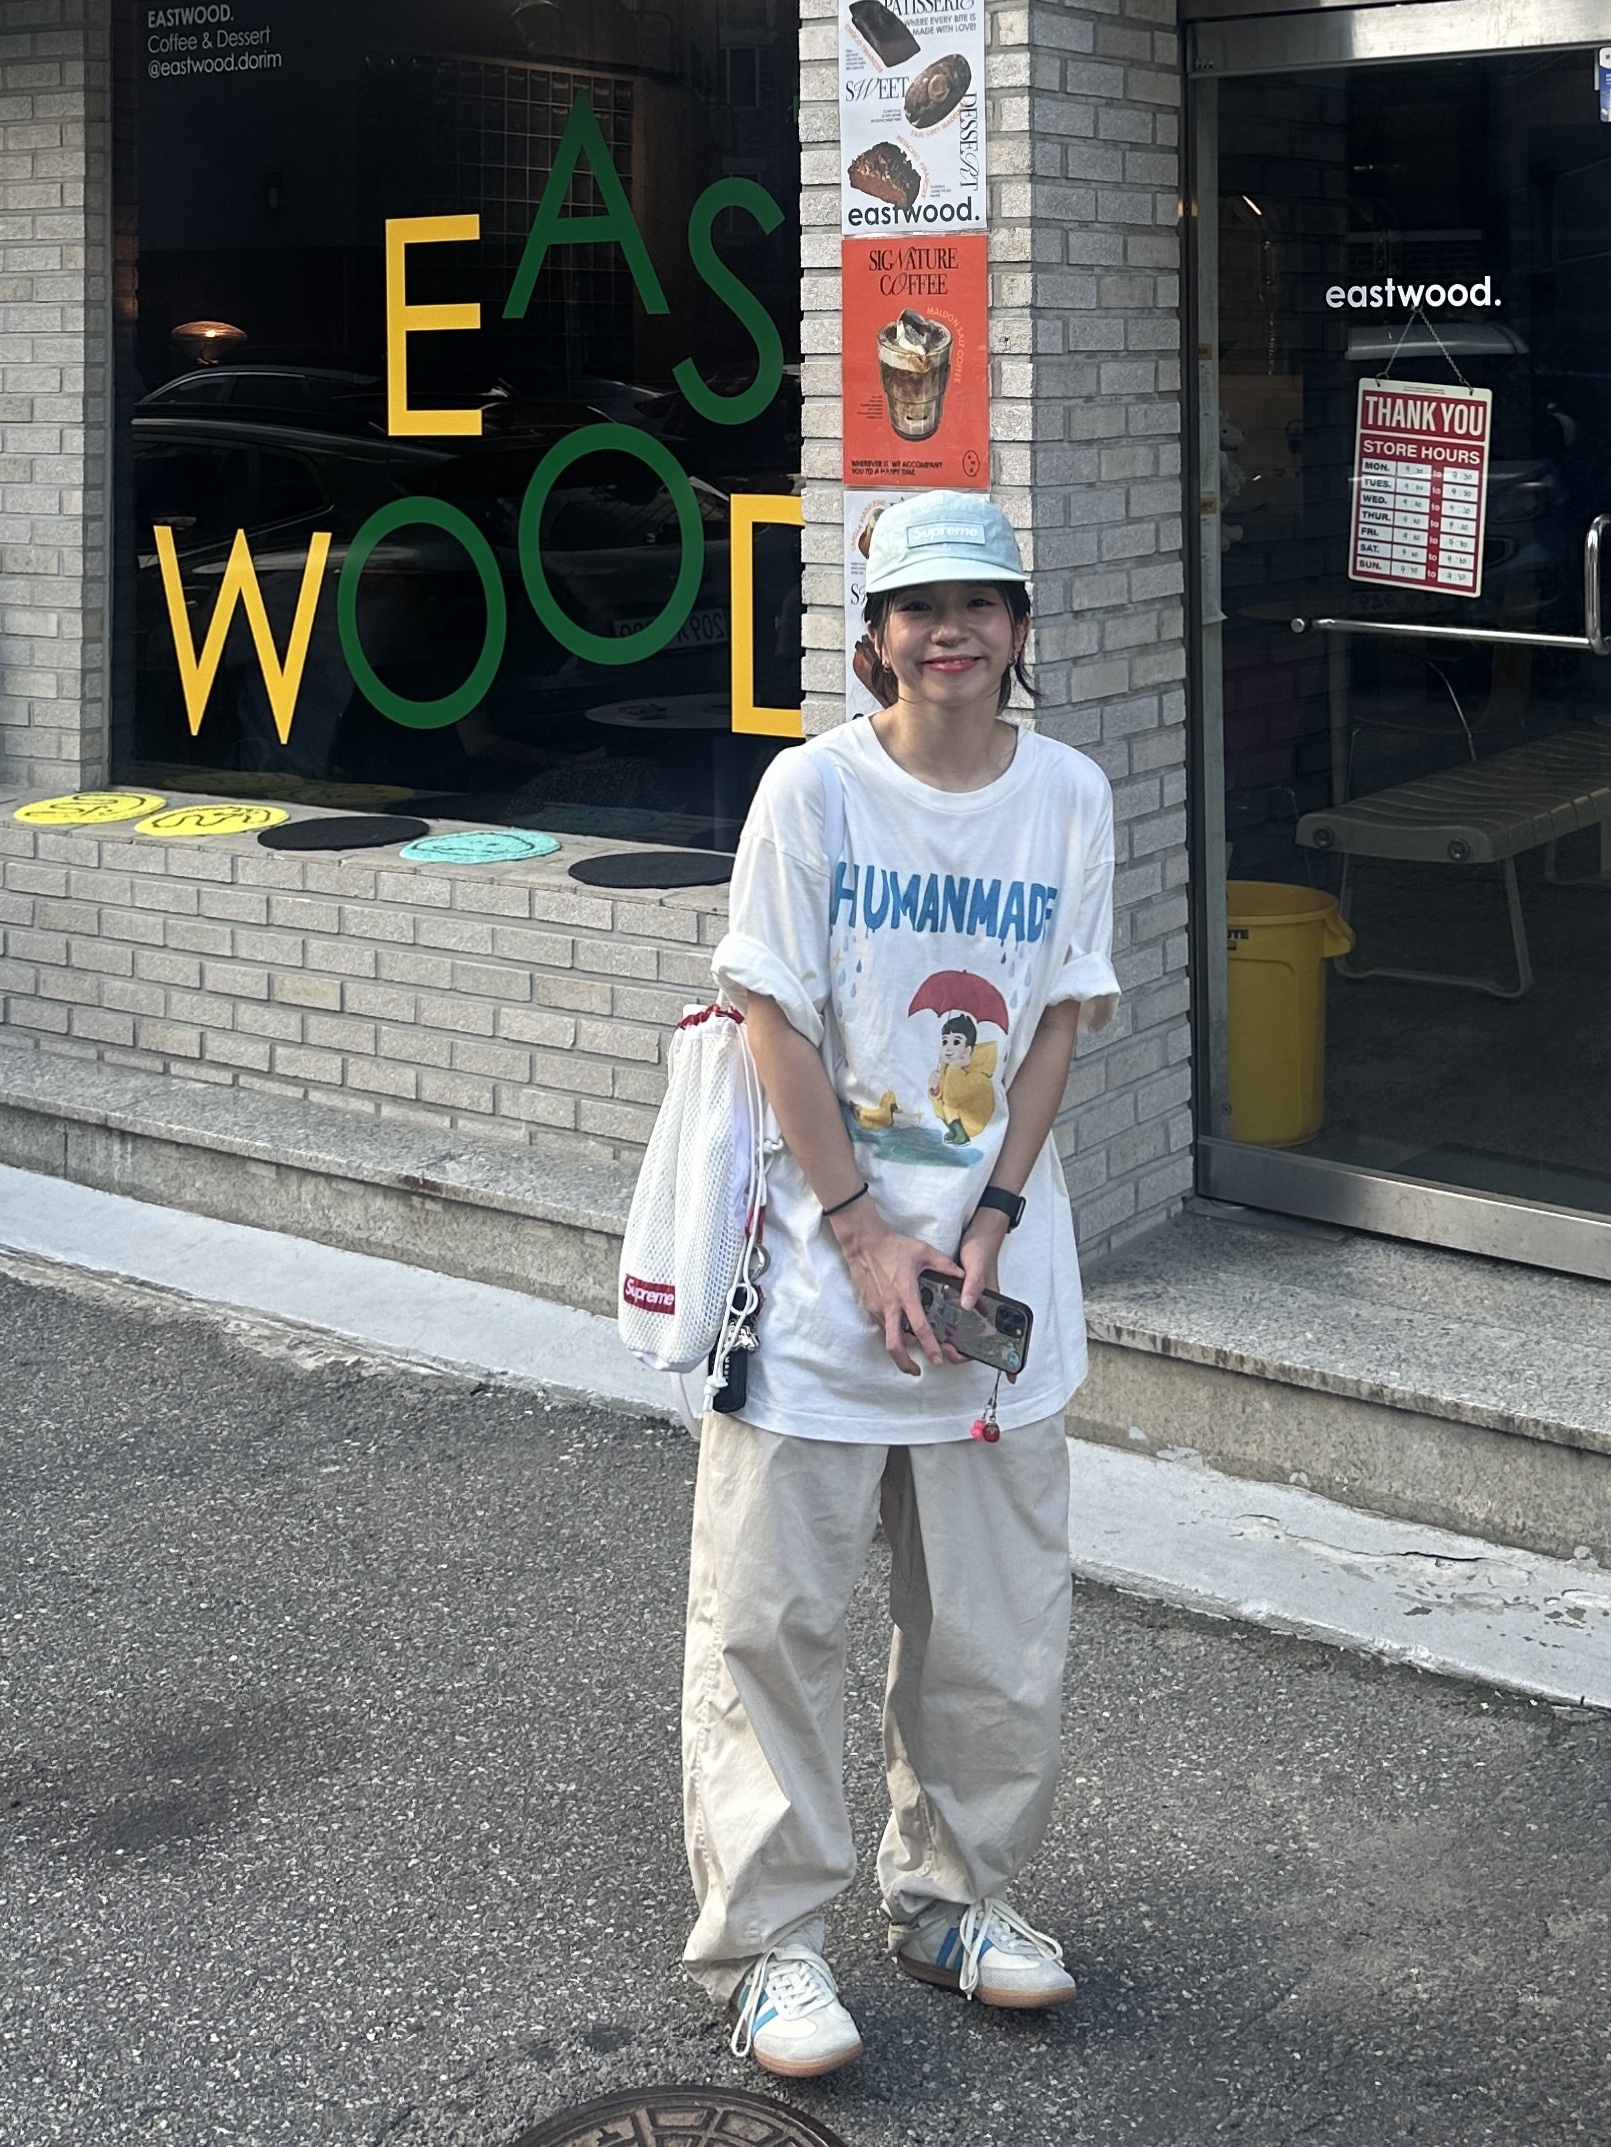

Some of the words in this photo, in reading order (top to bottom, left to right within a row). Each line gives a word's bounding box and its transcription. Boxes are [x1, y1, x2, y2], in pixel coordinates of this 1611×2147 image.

[147, 4, 235, 29] EASTWOOD.
[930, 15, 952, 25] EVERY
[147, 32, 198, 54] Coffee
[201, 32, 213, 49] &
[217, 25, 271, 48] Dessert
[912, 27, 935, 36] MADE
[147, 49, 282, 79] @eastwood.dorim
[846, 77, 910, 102] SWEET
[959, 92, 979, 191] DESSERT
[848, 196, 980, 226] eastwood.
[869, 247, 959, 272] SIGNATURE
[879, 272, 949, 296] COFFEE
[1325, 276, 1502, 309] eastwood.
[1365, 395, 1437, 432] THANK
[1441, 402, 1485, 437] YOU
[1363, 439, 1417, 458] STORE
[1420, 445, 1481, 465] HOURS
[1364, 461, 1390, 472] MON.
[1433, 470, 1442, 478] to
[1364, 478, 1392, 488] TUES.
[1432, 486, 1441, 494] to
[1362, 494, 1388, 504] WED.
[1431, 502, 1440, 511] to
[1362, 511, 1391, 522] THUR.
[1430, 519, 1439, 528] to
[911, 525, 979, 541] Supreme
[1360, 527, 1379, 536] FRI.
[1429, 536, 1438, 545] to
[1359, 543, 1380, 553] SAT.
[1428, 553, 1437, 562] to
[1359, 560, 1382, 570] SUN.
[1427, 570, 1436, 578] to
[625, 1279, 674, 1306] Supreme
